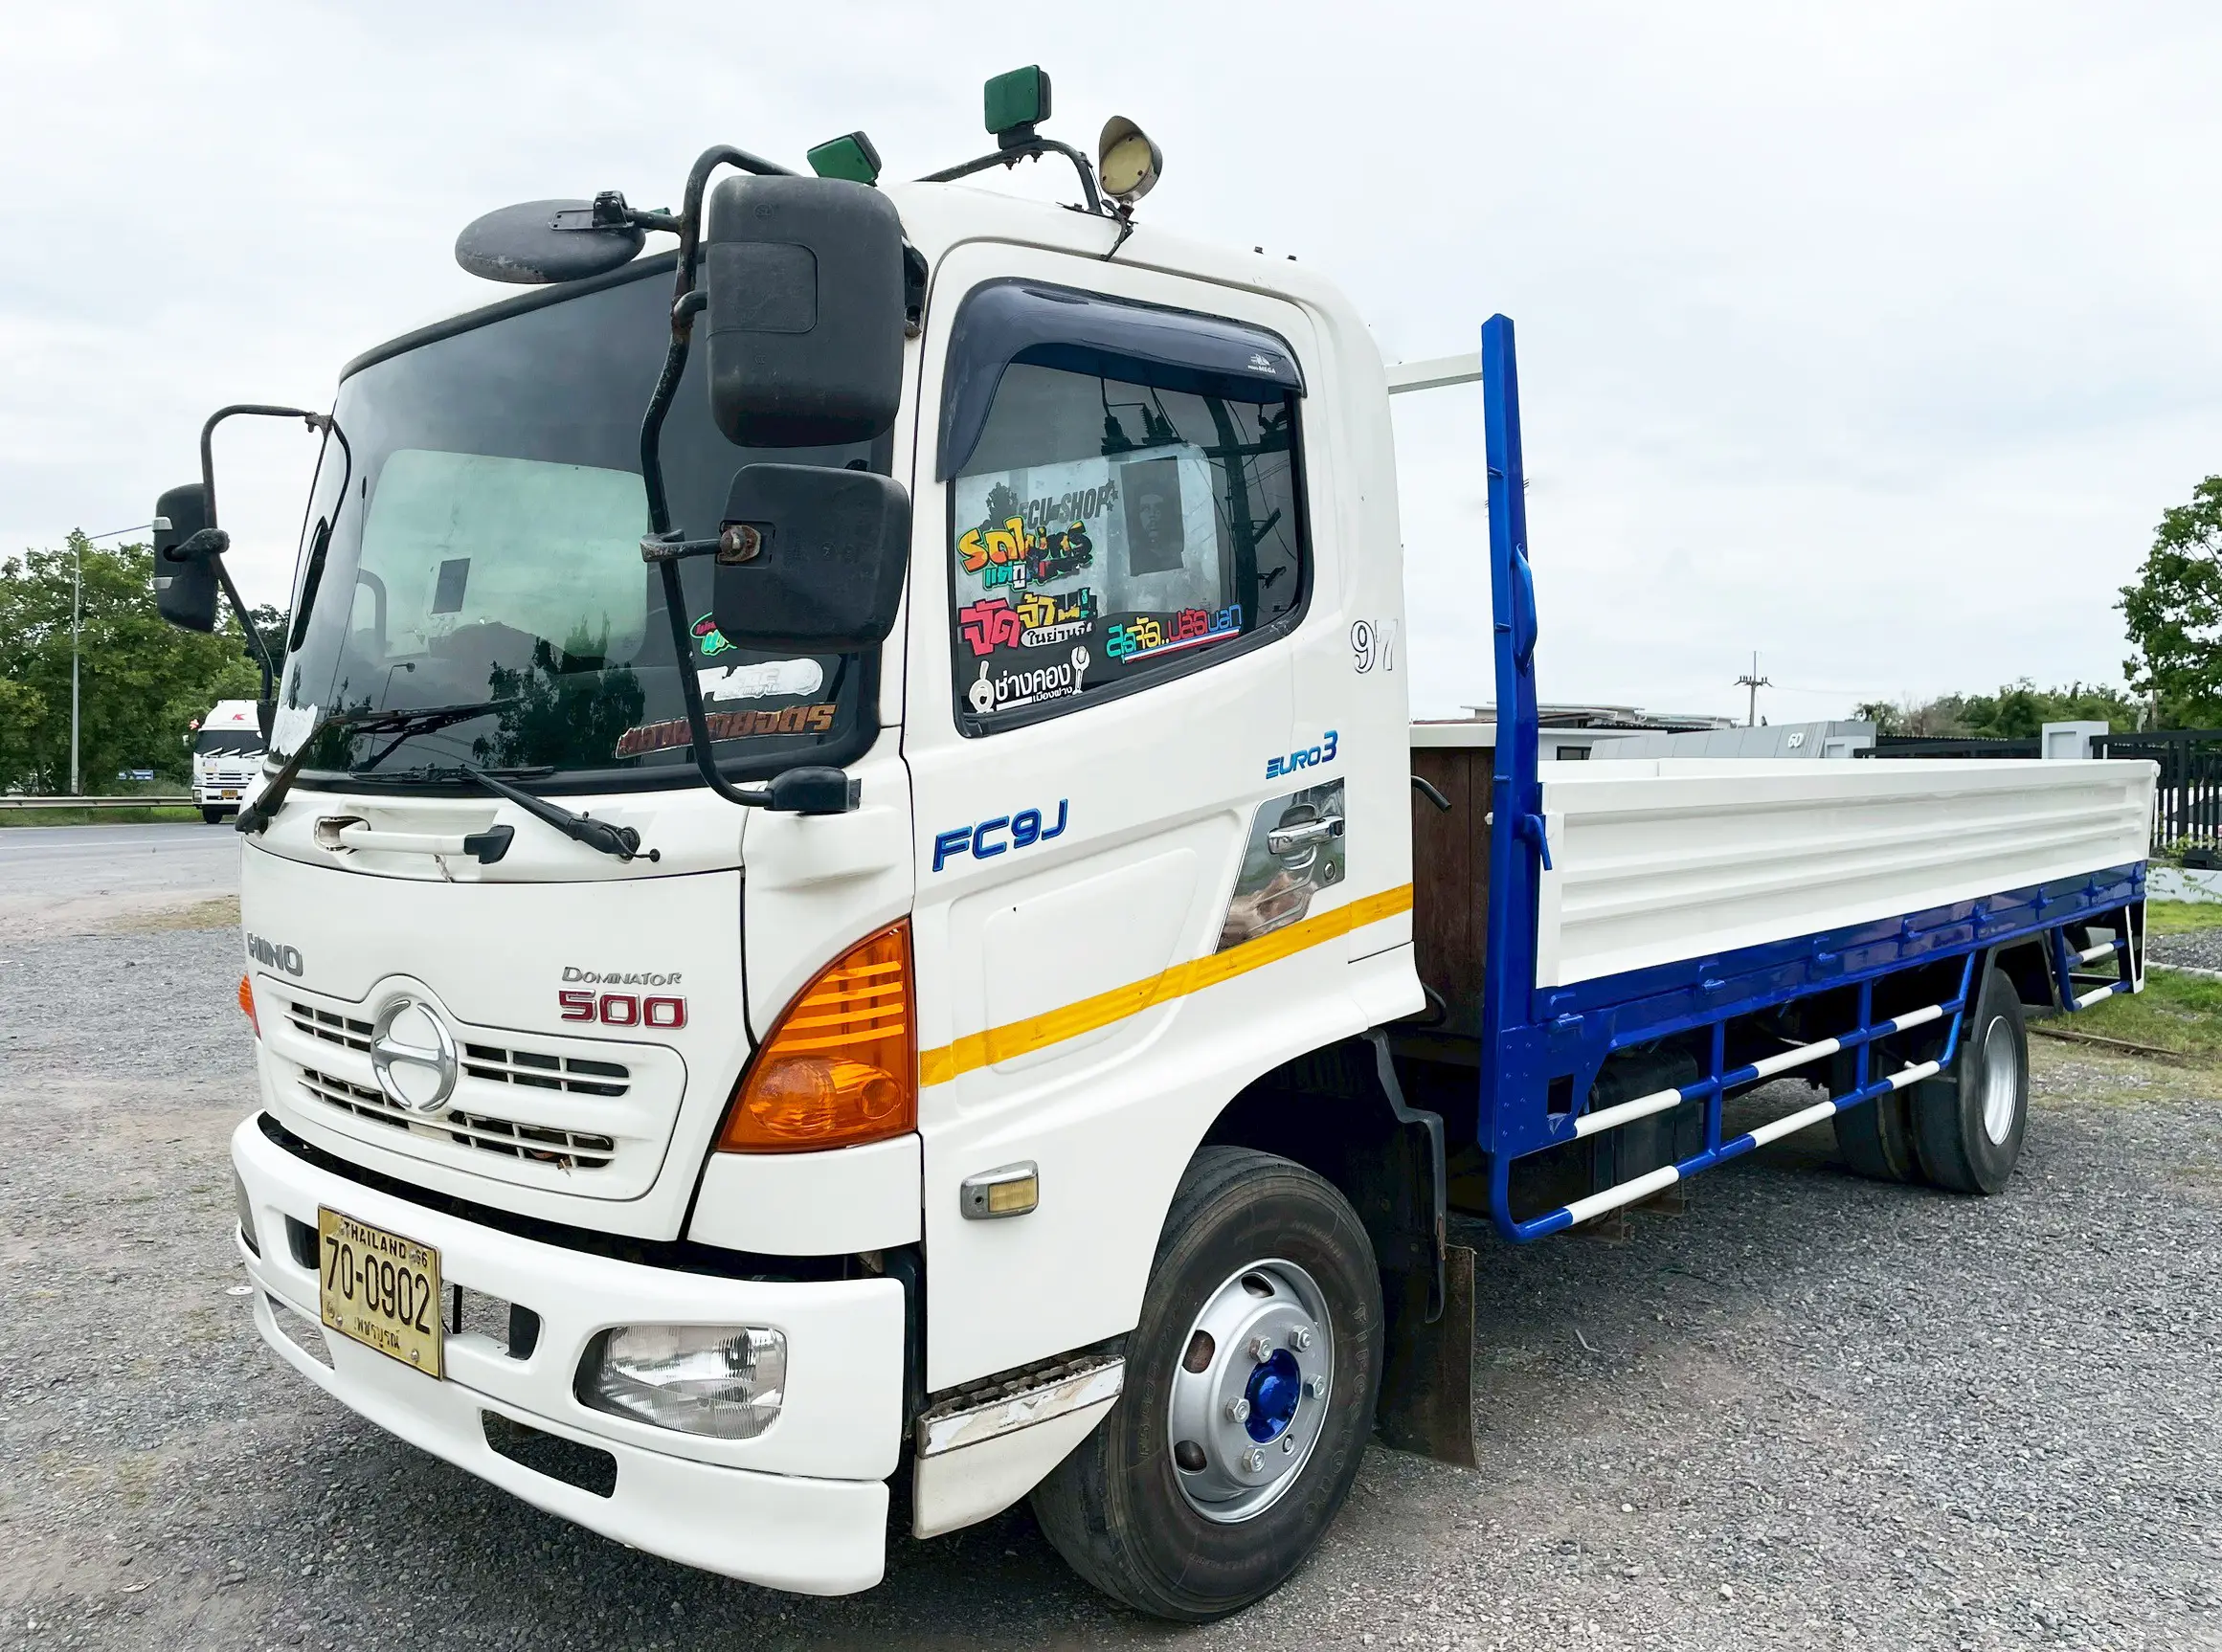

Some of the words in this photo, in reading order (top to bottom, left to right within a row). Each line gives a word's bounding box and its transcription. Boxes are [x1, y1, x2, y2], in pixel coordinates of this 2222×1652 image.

[1351, 620, 1399, 674] 97
[932, 798, 1068, 873] FC9J
[247, 931, 303, 977] HINO
[558, 987, 688, 1030] 500
[343, 1218, 406, 1260] THAILAND
[325, 1236, 431, 1335] 70-0902
